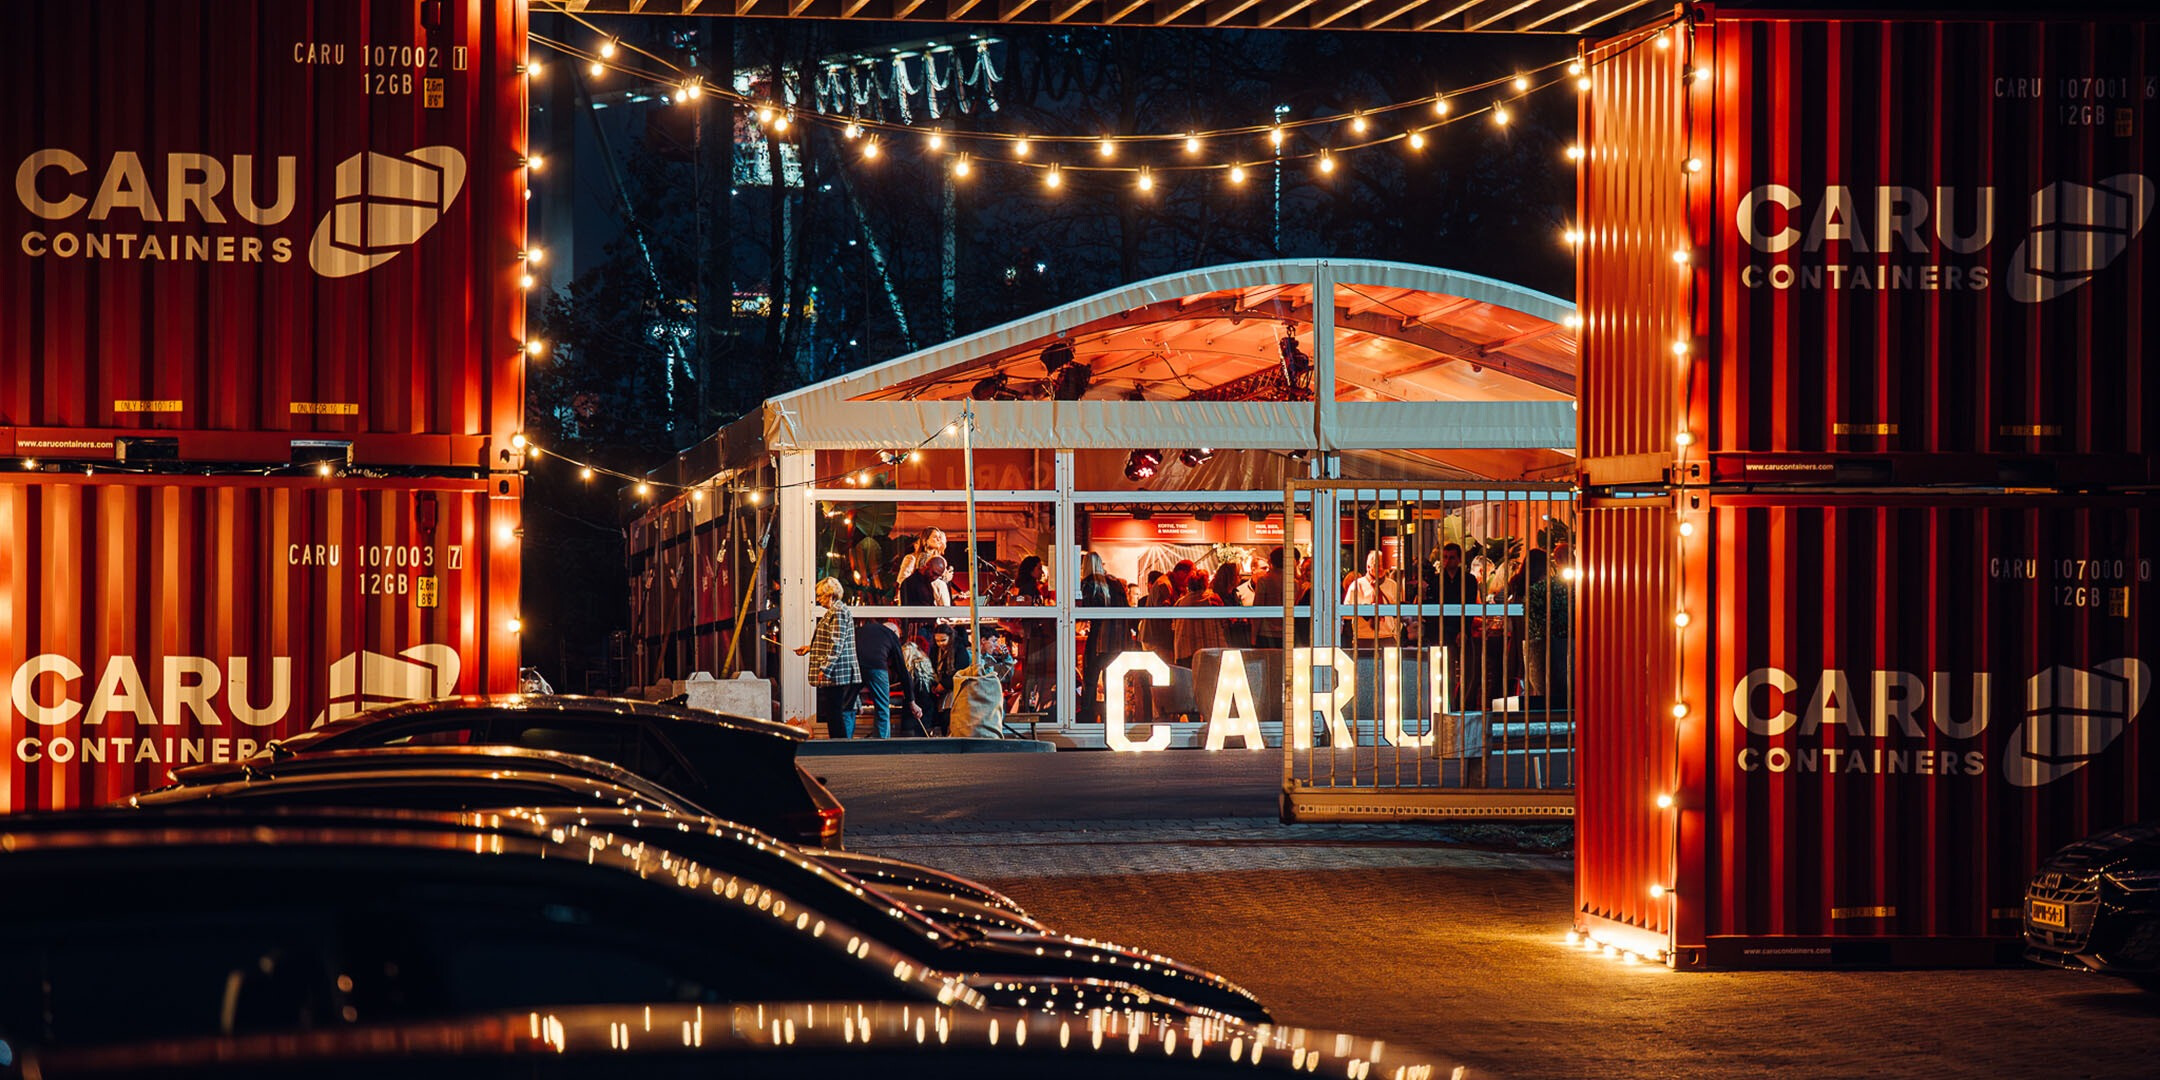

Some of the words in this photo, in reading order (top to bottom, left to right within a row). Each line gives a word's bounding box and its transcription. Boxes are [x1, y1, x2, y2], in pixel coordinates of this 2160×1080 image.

[294, 42, 344, 65] CARU
[363, 45, 439, 68] 107002
[364, 74, 412, 95] 12GB
[1994, 77, 2042, 98] CARU
[2058, 77, 2128, 99] 107001
[2058, 104, 2105, 126] 12GB
[15, 148, 297, 226] CARU
[1736, 184, 1996, 254] CARU
[21, 231, 293, 263] CONTAINERS
[1741, 264, 1990, 290] CONTAINERS
[17, 439, 113, 449] www.carucontainers.com
[1745, 463, 1834, 472] www.carucontainers.com
[289, 544, 339, 567] CARU
[359, 546, 433, 568] 107003
[448, 545, 462, 569] 7
[1990, 558, 2037, 580] CARU
[2054, 559, 2125, 581] 107000
[360, 574, 408, 595] 12GB
[2054, 585, 2102, 607] 12GB
[11, 653, 292, 727] CARU
[1105, 647, 1449, 751] CARU
[1733, 667, 1993, 739] CARU
[16, 737, 284, 764] CONTAINER
[1737, 747, 1986, 775] CONTAINERS
[1744, 947, 1832, 956] www.carucontainers.com
